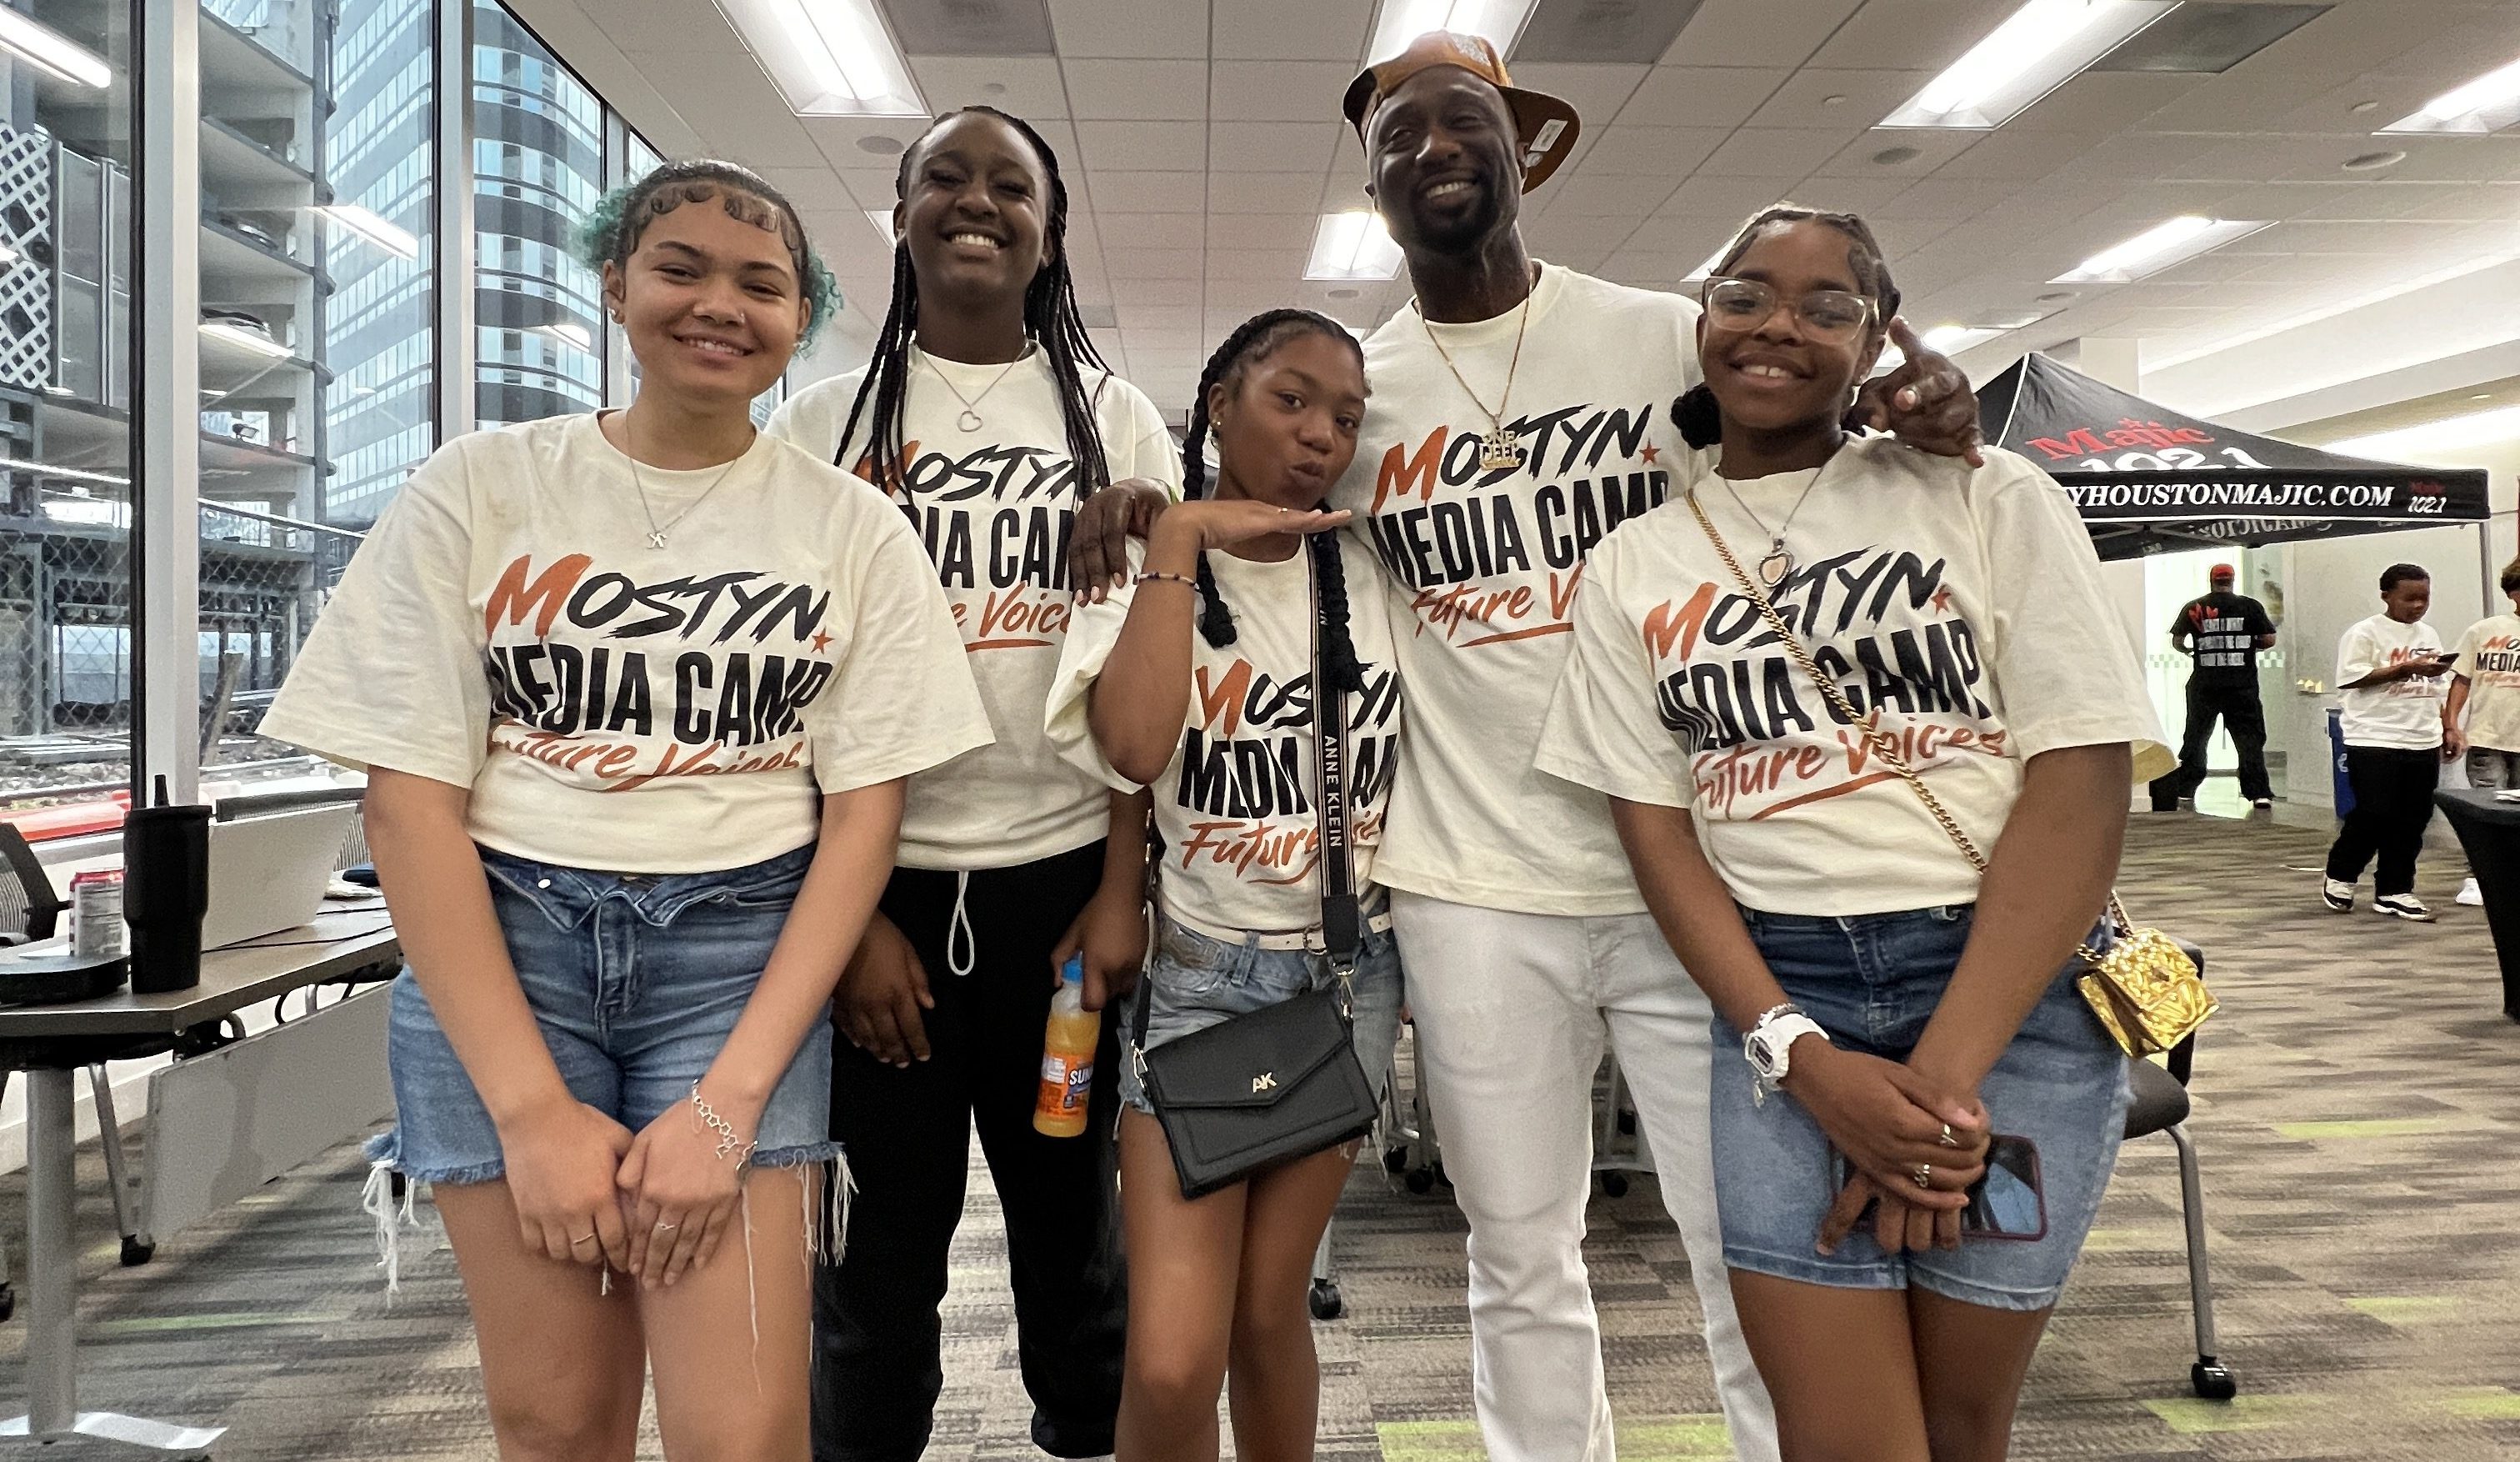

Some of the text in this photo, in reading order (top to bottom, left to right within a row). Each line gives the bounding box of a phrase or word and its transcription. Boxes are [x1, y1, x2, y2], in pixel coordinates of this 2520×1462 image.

[2025, 418, 2215, 460] Majic
[1368, 494, 1531, 591] MEDIA
[2065, 483, 2395, 508] YHOUSTONMAJIC.COM
[485, 553, 831, 647] MOSTYN
[674, 651, 833, 747] CAMP
[1814, 618, 1992, 723] CAMP
[1838, 706, 2006, 775] Voices
[1324, 735, 1342, 847] ANNE KLEIN
[1252, 1072, 1278, 1094] AK
